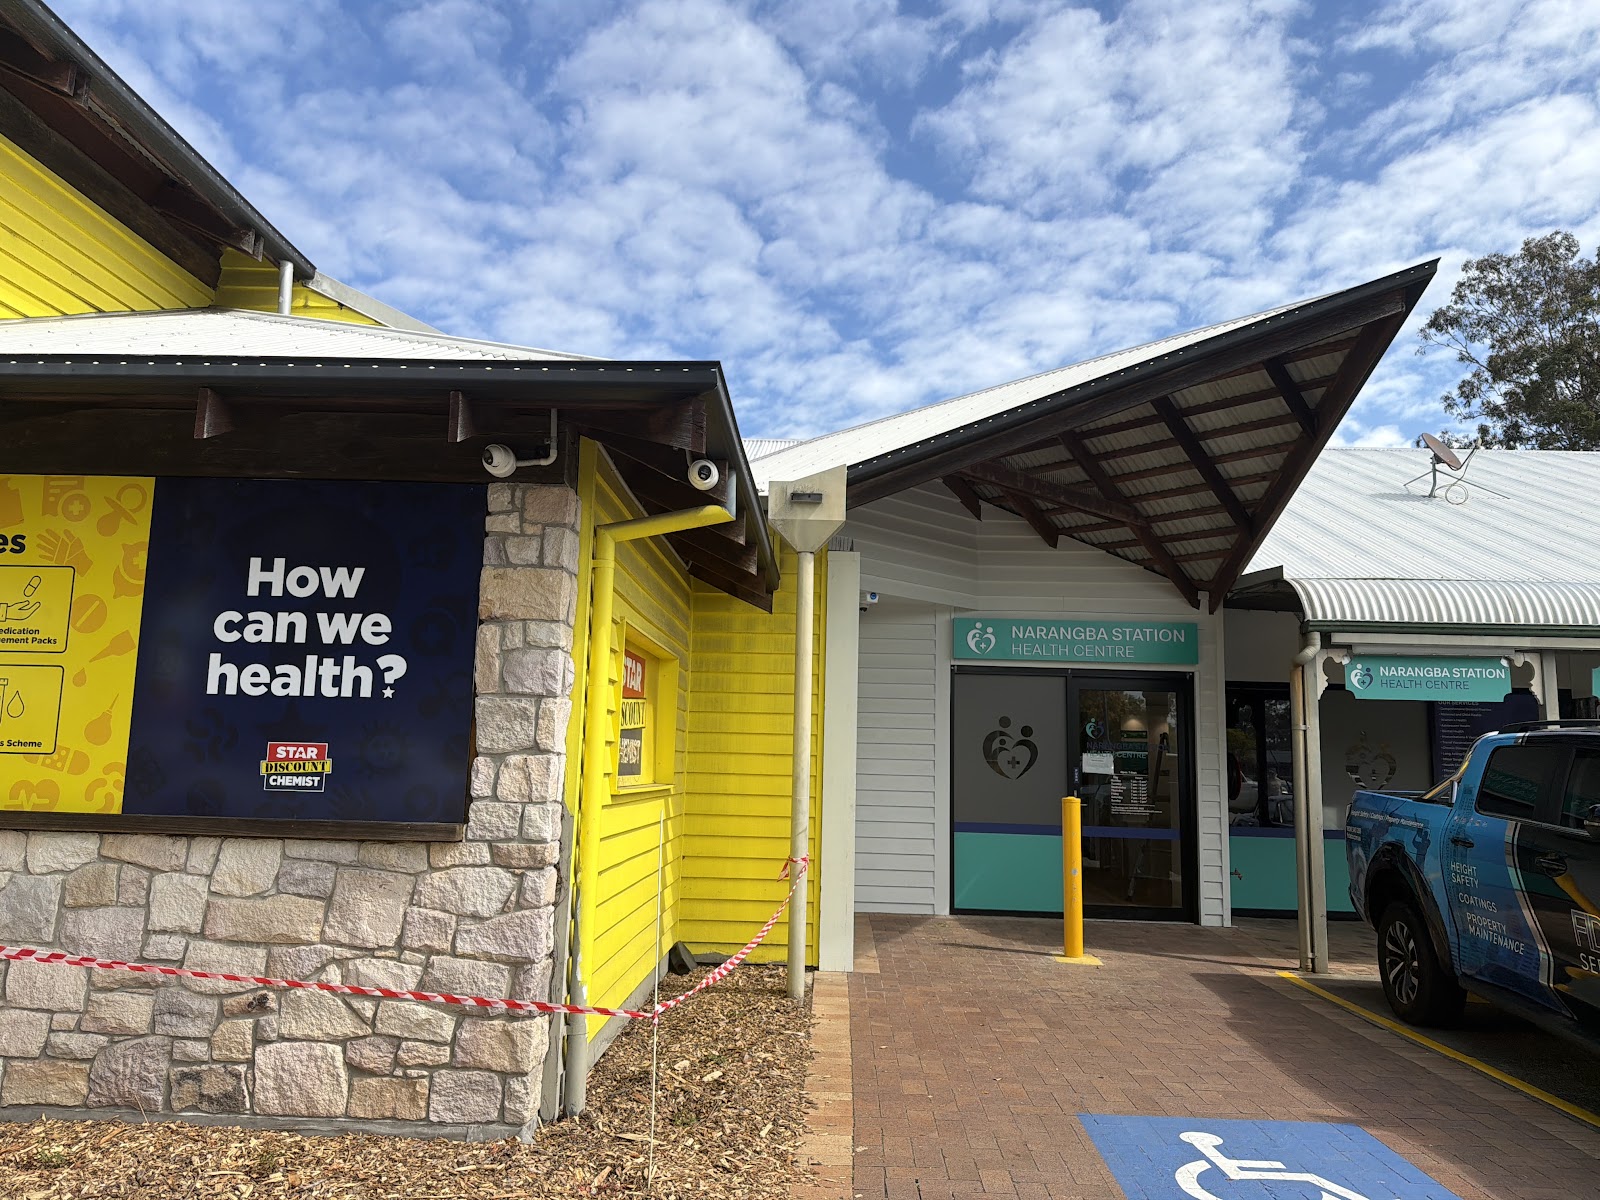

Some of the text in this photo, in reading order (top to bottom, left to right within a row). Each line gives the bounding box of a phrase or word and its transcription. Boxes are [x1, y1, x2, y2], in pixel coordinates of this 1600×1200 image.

[247, 557, 366, 598] How
[213, 610, 392, 646] can we
[1011, 625, 1185, 643] NARANGBA STATION
[31, 637, 58, 645] Packs
[1011, 643, 1135, 658] HEALTH CENTRE
[206, 652, 408, 699] health?
[1379, 666, 1505, 679] NARANGBA STATION
[1380, 679, 1470, 690] HEALTH CENTRE
[6, 739, 43, 748] Scheme
[276, 746, 318, 759] STAR
[1116, 751, 1147, 759] CENTRE
[265, 761, 328, 773] DISCOUNT
[269, 775, 321, 787] CHEMIST
[1450, 861, 1477, 877] HEIGHT
[1451, 872, 1479, 889] SAFETY
[1458, 892, 1498, 914] COATINGS
[1466, 912, 1507, 935] PROPERTY
[1468, 924, 1525, 955] MAINTENANCE
